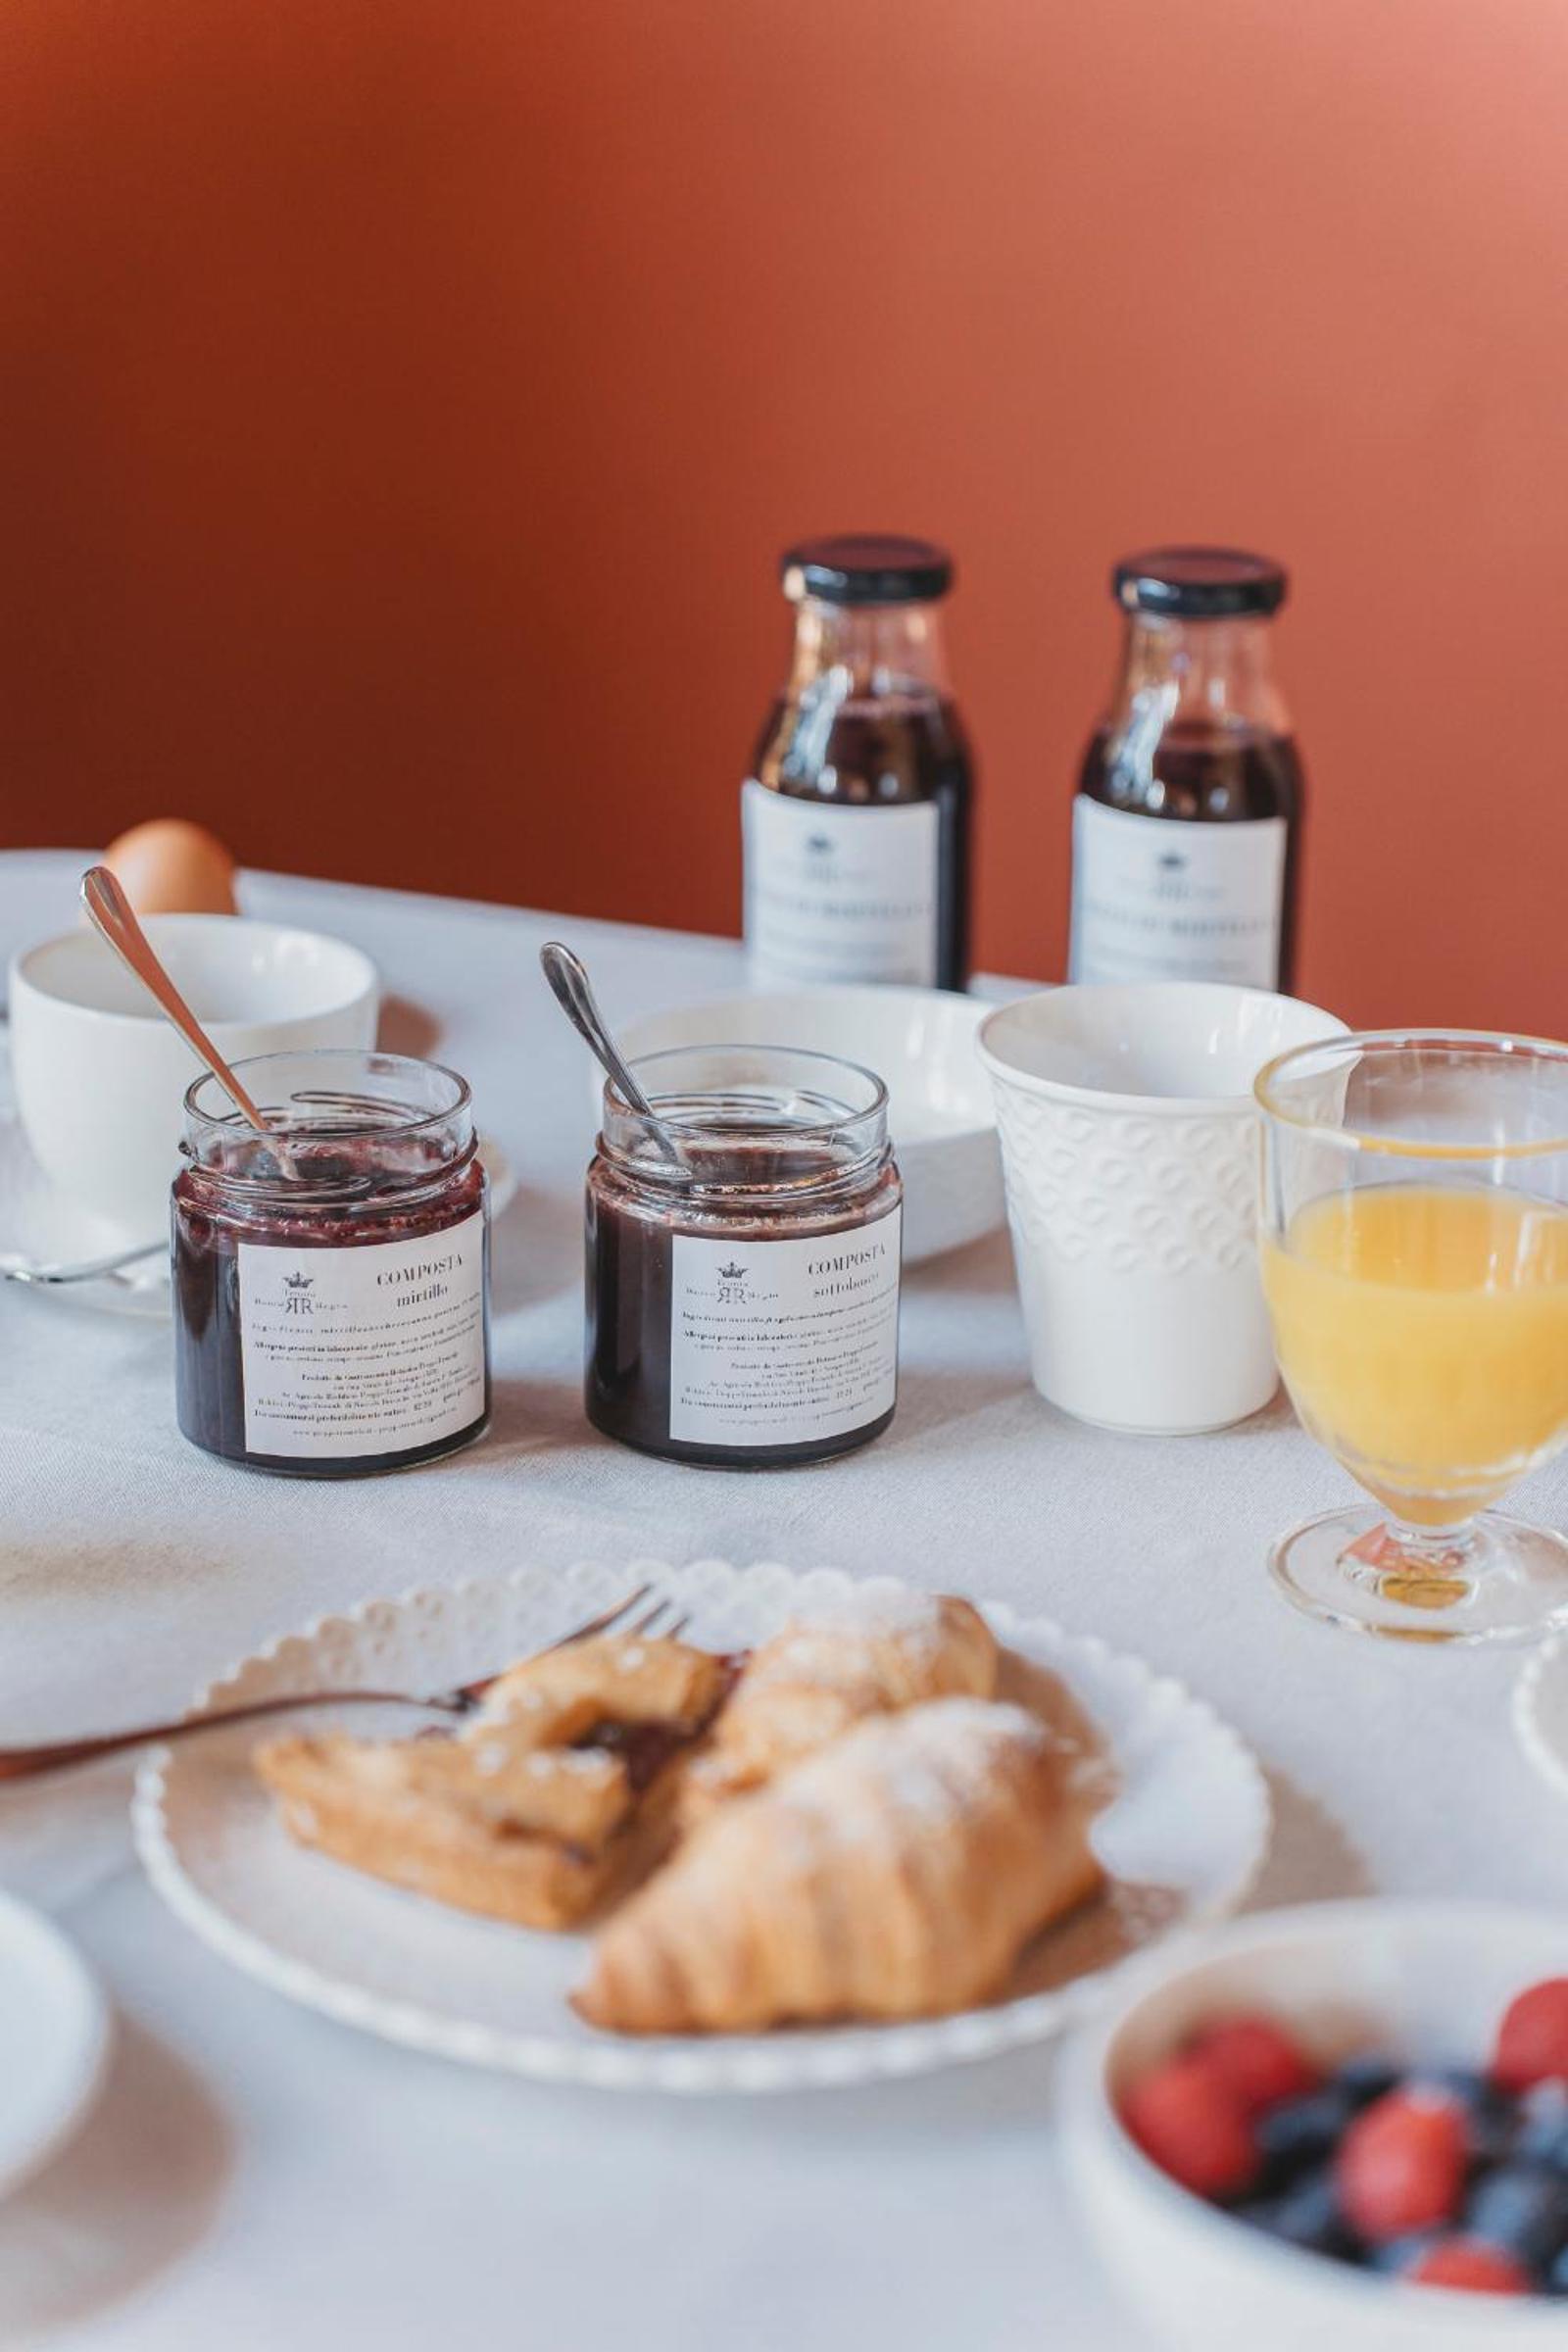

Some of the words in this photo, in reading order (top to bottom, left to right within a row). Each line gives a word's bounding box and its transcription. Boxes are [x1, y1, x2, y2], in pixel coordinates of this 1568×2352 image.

[377, 1253, 463, 1286] COMPOSTA
[808, 1242, 886, 1275] COMPOSTA
[397, 1283, 449, 1308] mirtillo
